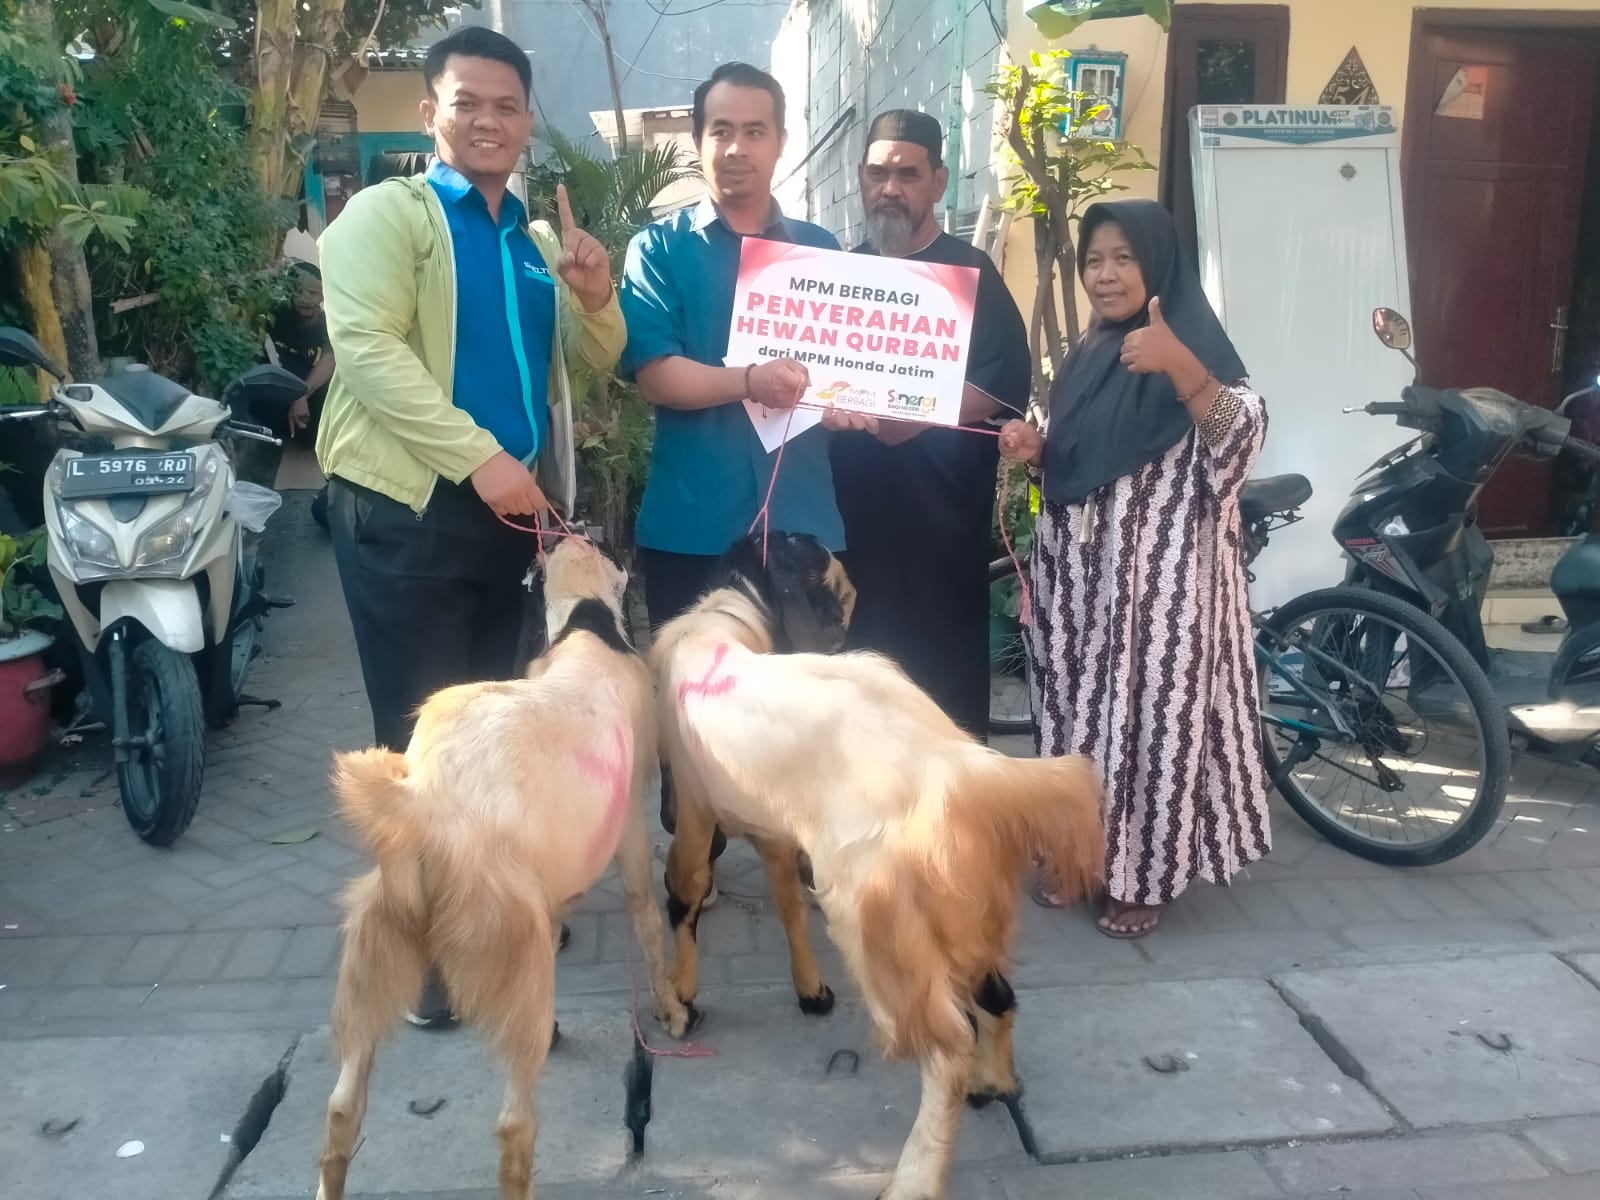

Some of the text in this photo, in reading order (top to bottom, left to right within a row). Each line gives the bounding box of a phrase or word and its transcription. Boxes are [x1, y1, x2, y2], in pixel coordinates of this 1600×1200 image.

[789, 276, 920, 307] MPM BERBAGI
[747, 292, 957, 338] PENYERAHAN
[736, 315, 960, 362] HEWAN QURBAN
[758, 345, 935, 379] dari MPM Honda Jatim
[836, 394, 876, 408] BERBAGI
[72, 461, 85, 476] L
[100, 459, 147, 474] 5976
